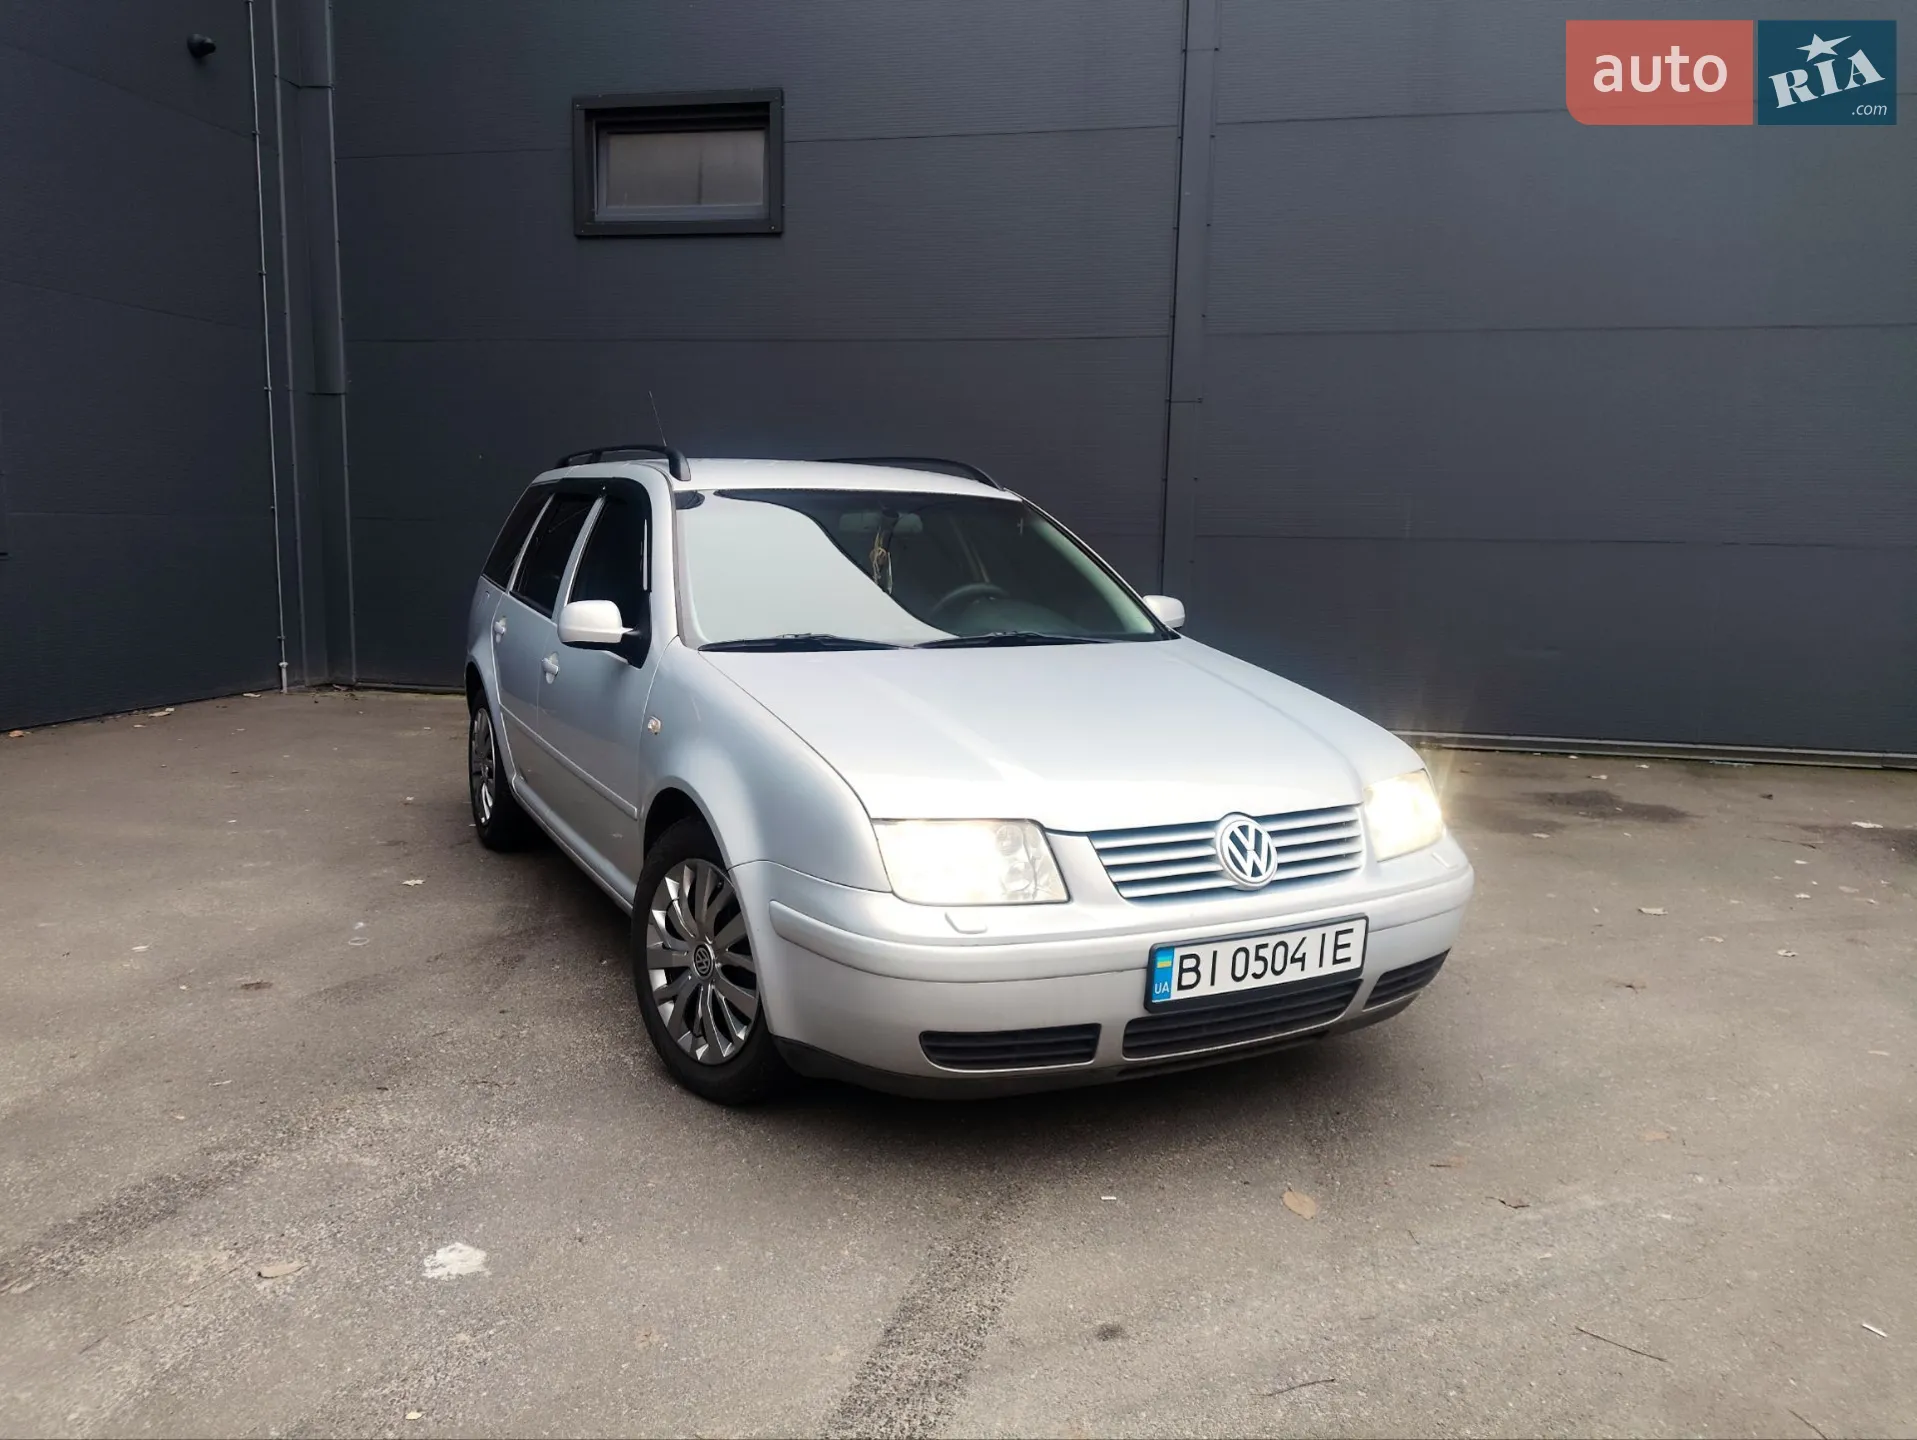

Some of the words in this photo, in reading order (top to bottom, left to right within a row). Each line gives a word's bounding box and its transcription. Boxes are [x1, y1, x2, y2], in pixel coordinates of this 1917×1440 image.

[1177, 950, 1218, 991] BI
[1230, 936, 1307, 983] 0504
[1319, 928, 1355, 969] IE
[1154, 981, 1170, 995] UA
